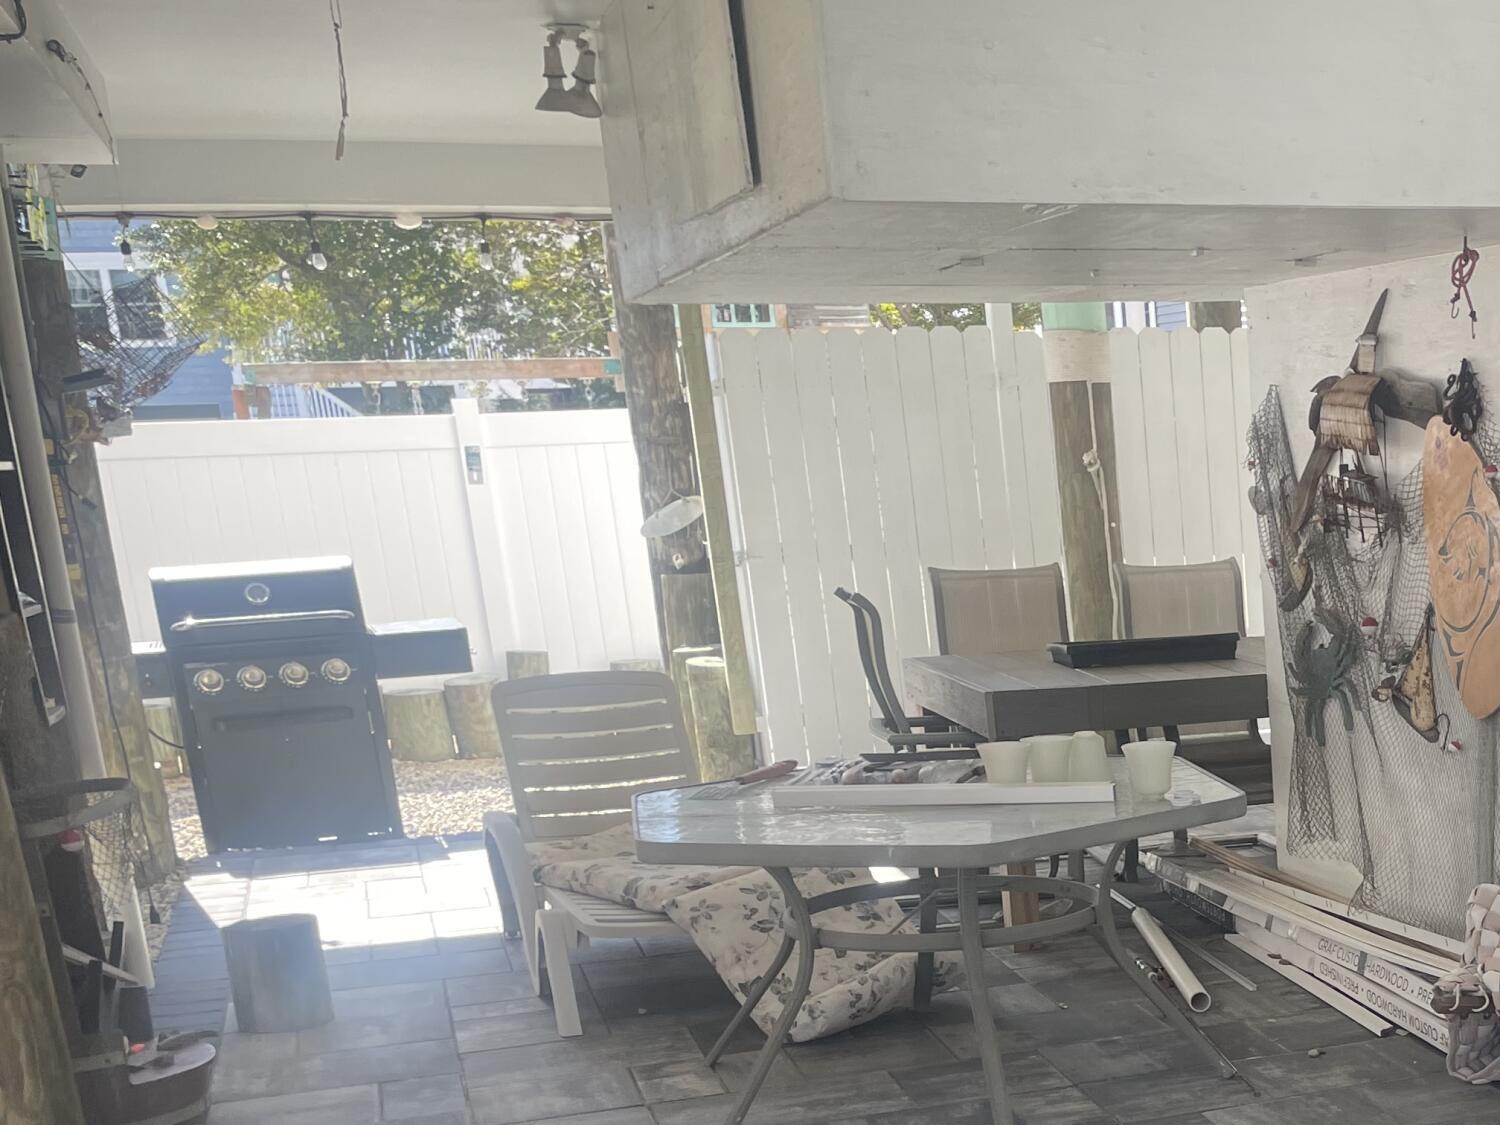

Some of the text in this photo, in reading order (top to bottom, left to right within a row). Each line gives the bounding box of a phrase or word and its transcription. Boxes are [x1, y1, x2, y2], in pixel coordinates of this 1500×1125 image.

[1336, 947, 1361, 967] CUSTO
[1365, 960, 1409, 992] HARDWOOD
[1366, 989, 1407, 1022] HARDWOOD
[1408, 1013, 1439, 1042] CUSTOM
